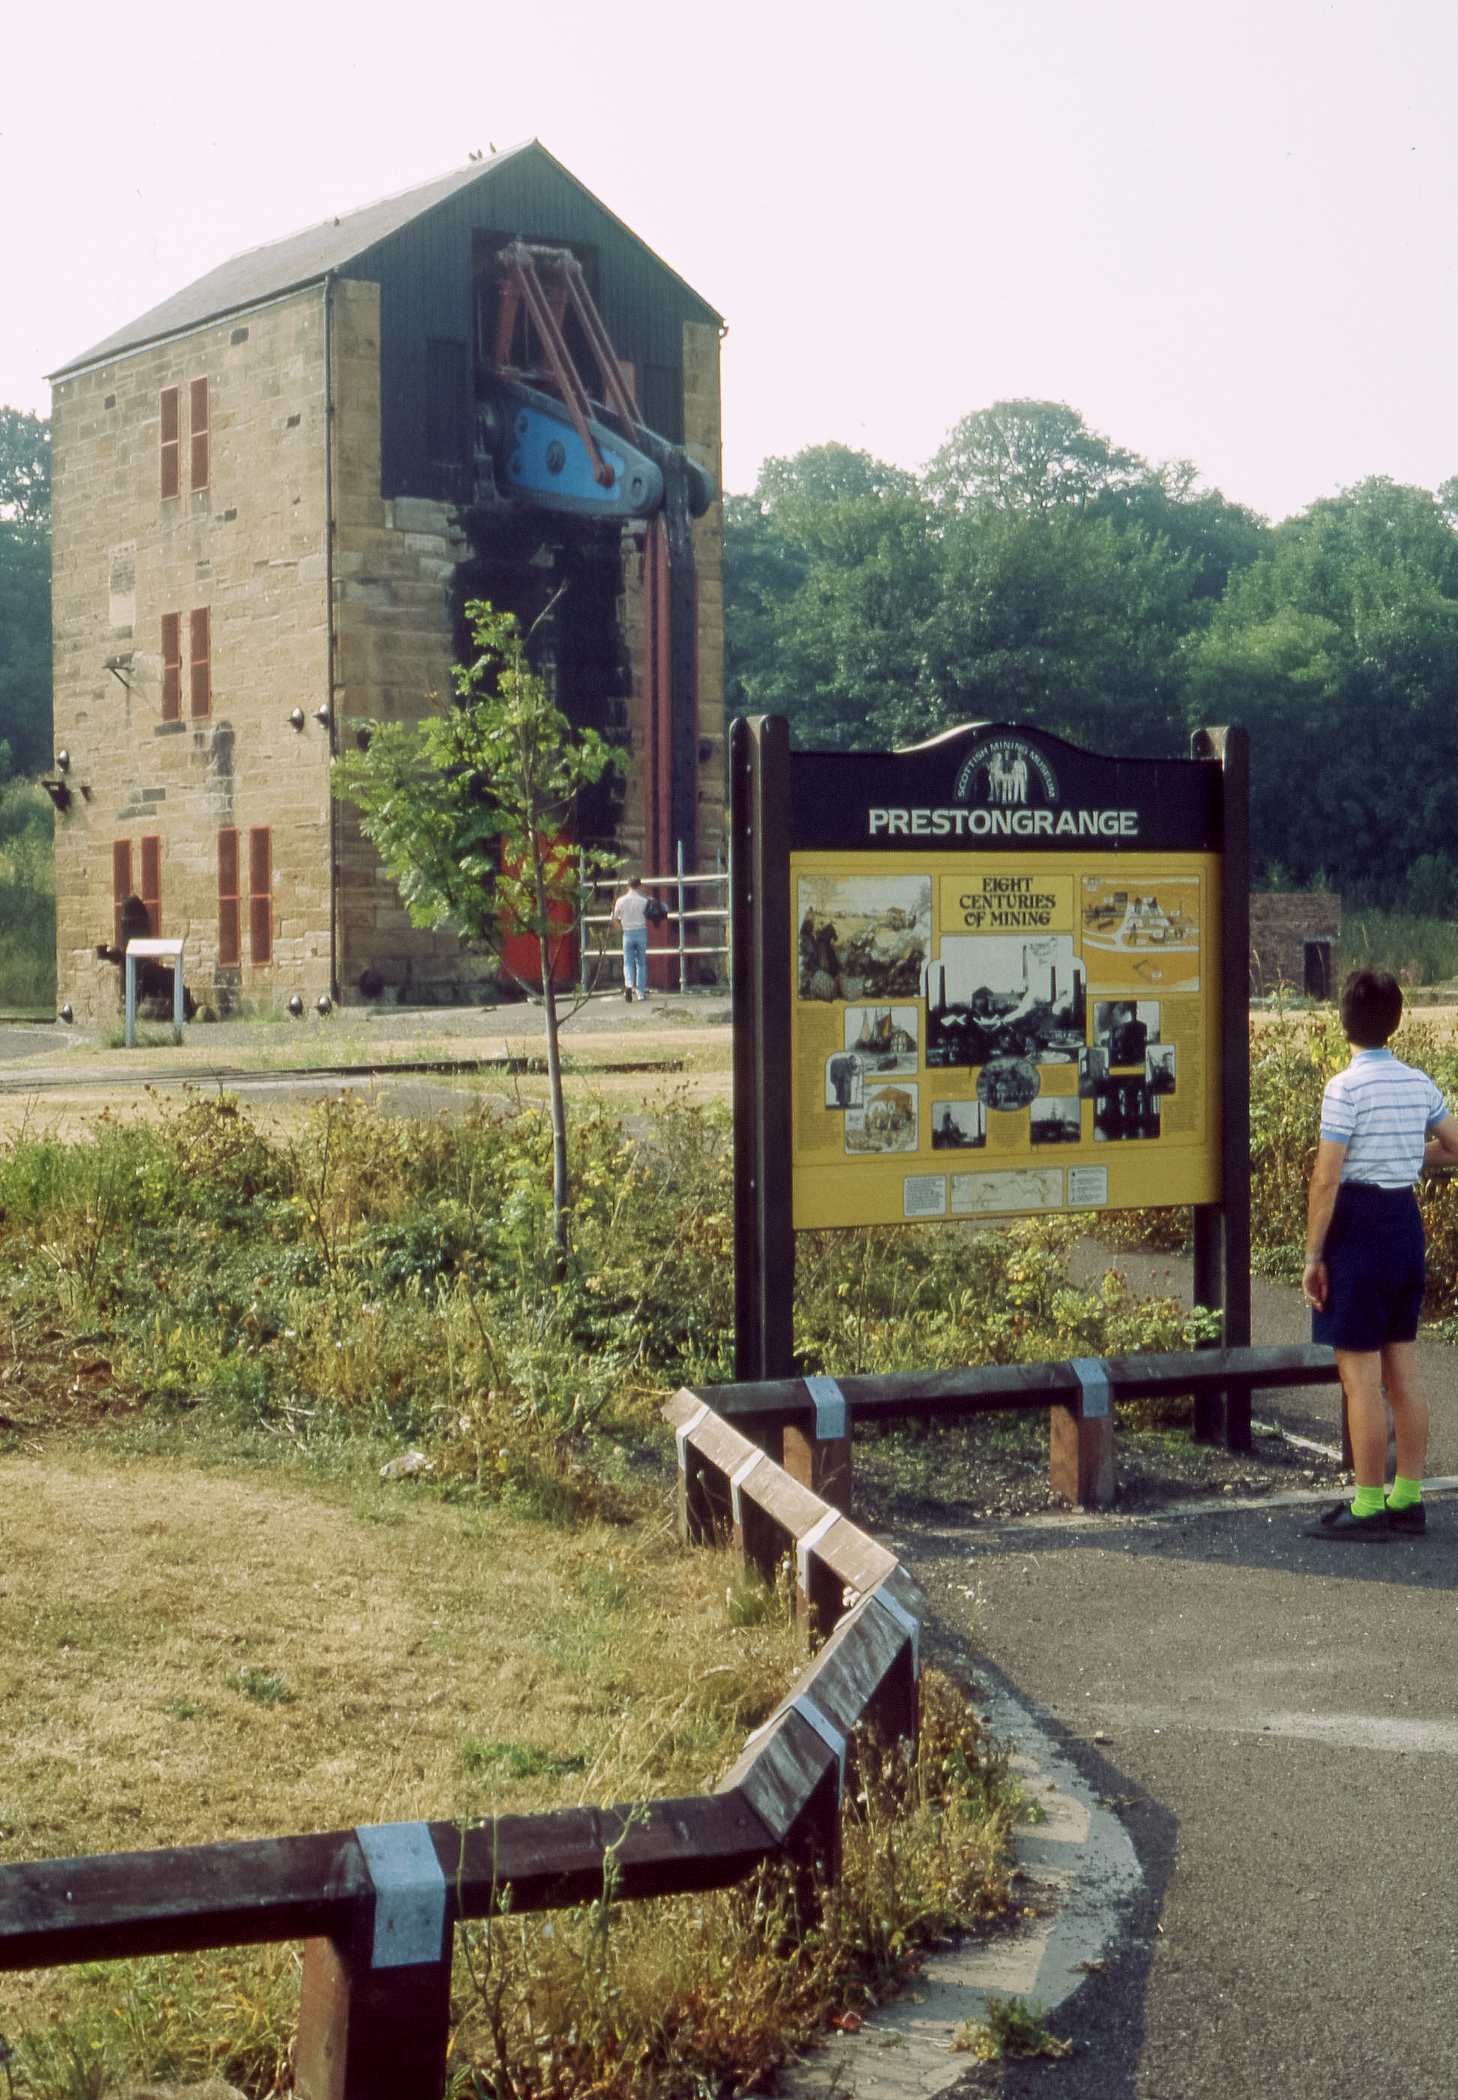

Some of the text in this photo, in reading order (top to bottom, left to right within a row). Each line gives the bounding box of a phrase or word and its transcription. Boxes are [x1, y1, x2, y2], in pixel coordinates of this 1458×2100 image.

[957, 741, 1056, 798] SCOTTISH MINING MUSEUM
[868, 809, 1138, 836] PRESTONGRANGE
[983, 877, 1034, 893] EIGHT
[959, 894, 1057, 910] CENTURIES
[964, 911, 1052, 928] OF MINING
